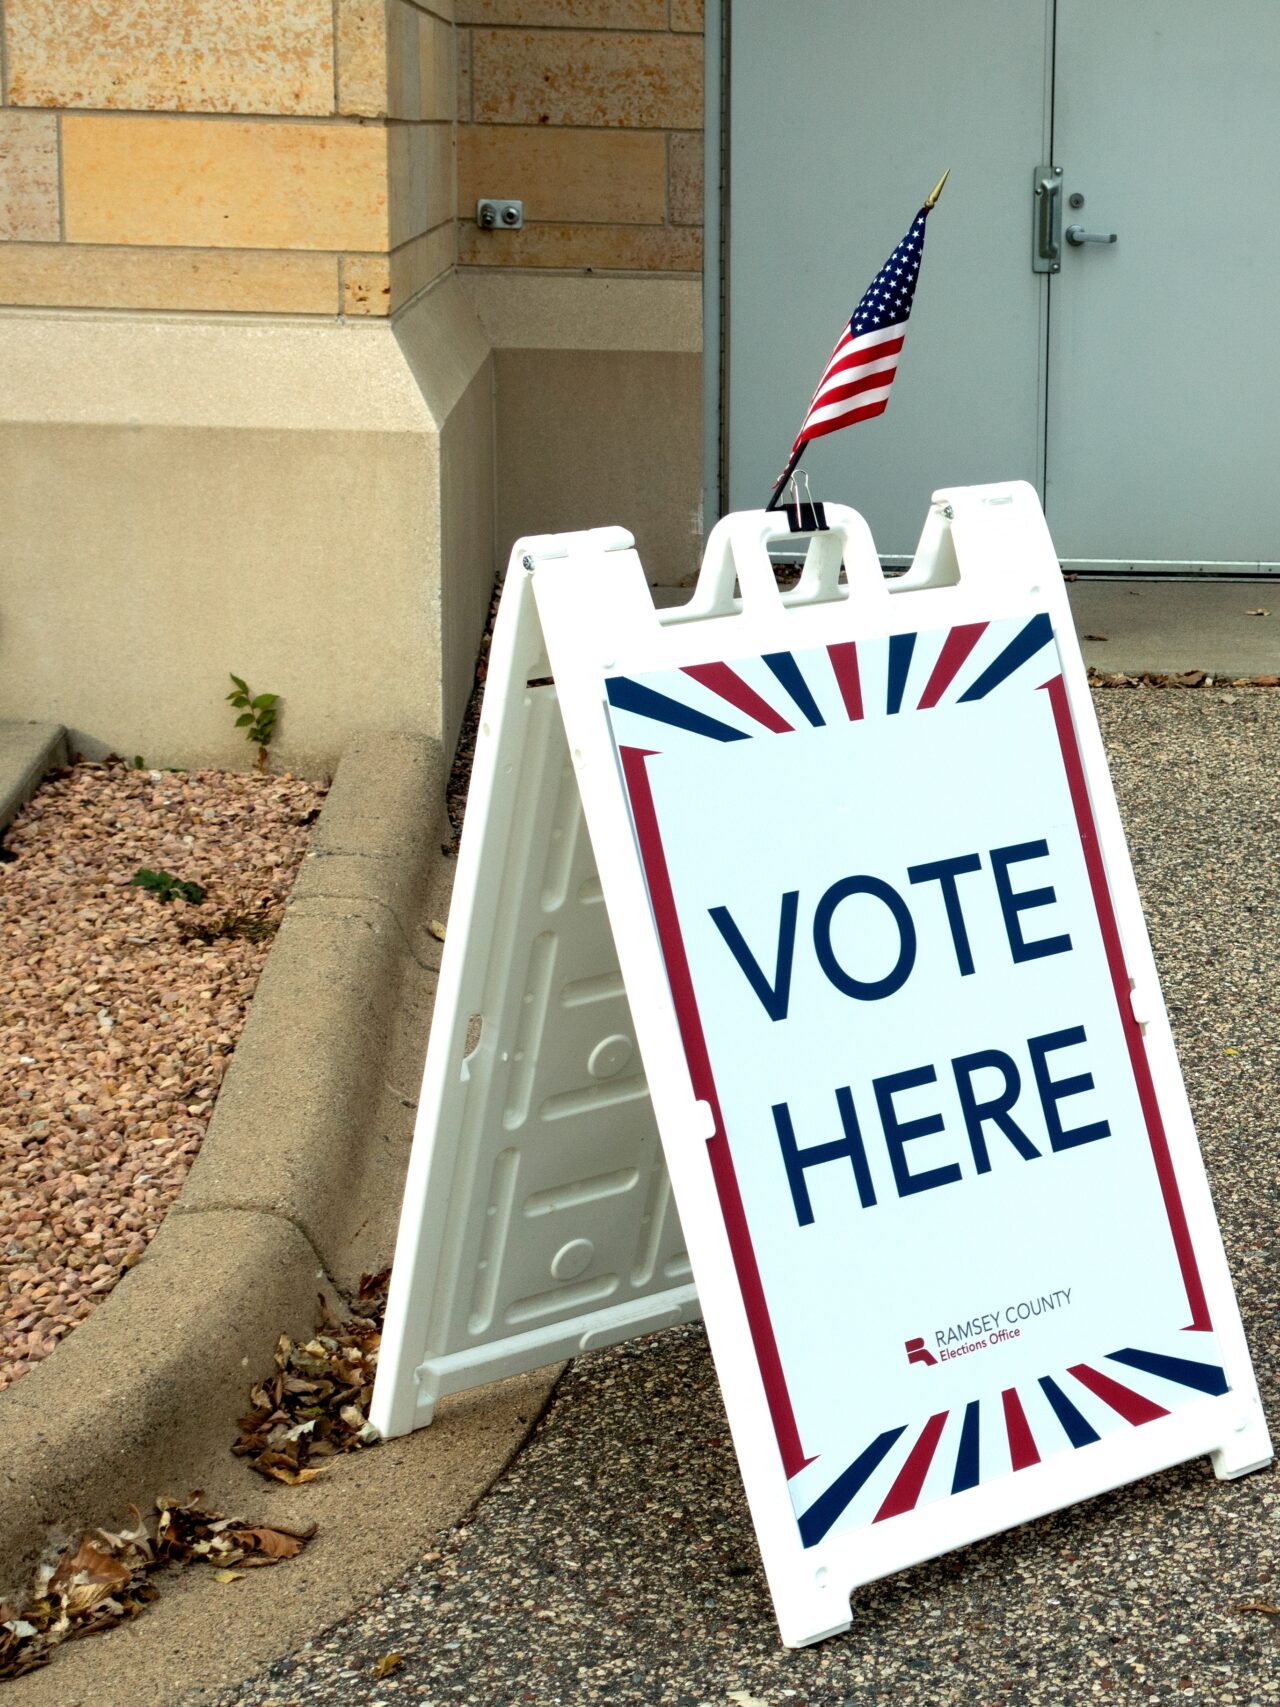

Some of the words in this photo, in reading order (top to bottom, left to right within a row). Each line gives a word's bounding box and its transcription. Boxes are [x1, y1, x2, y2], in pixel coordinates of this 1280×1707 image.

[707, 838, 1074, 1022] VOTE
[771, 1025, 1112, 1228] HERE
[935, 1311, 1000, 1348] RAMSEY
[1005, 1288, 1071, 1324] COUNTY
[939, 1338, 987, 1362] Elections
[989, 1327, 1021, 1345] Office
